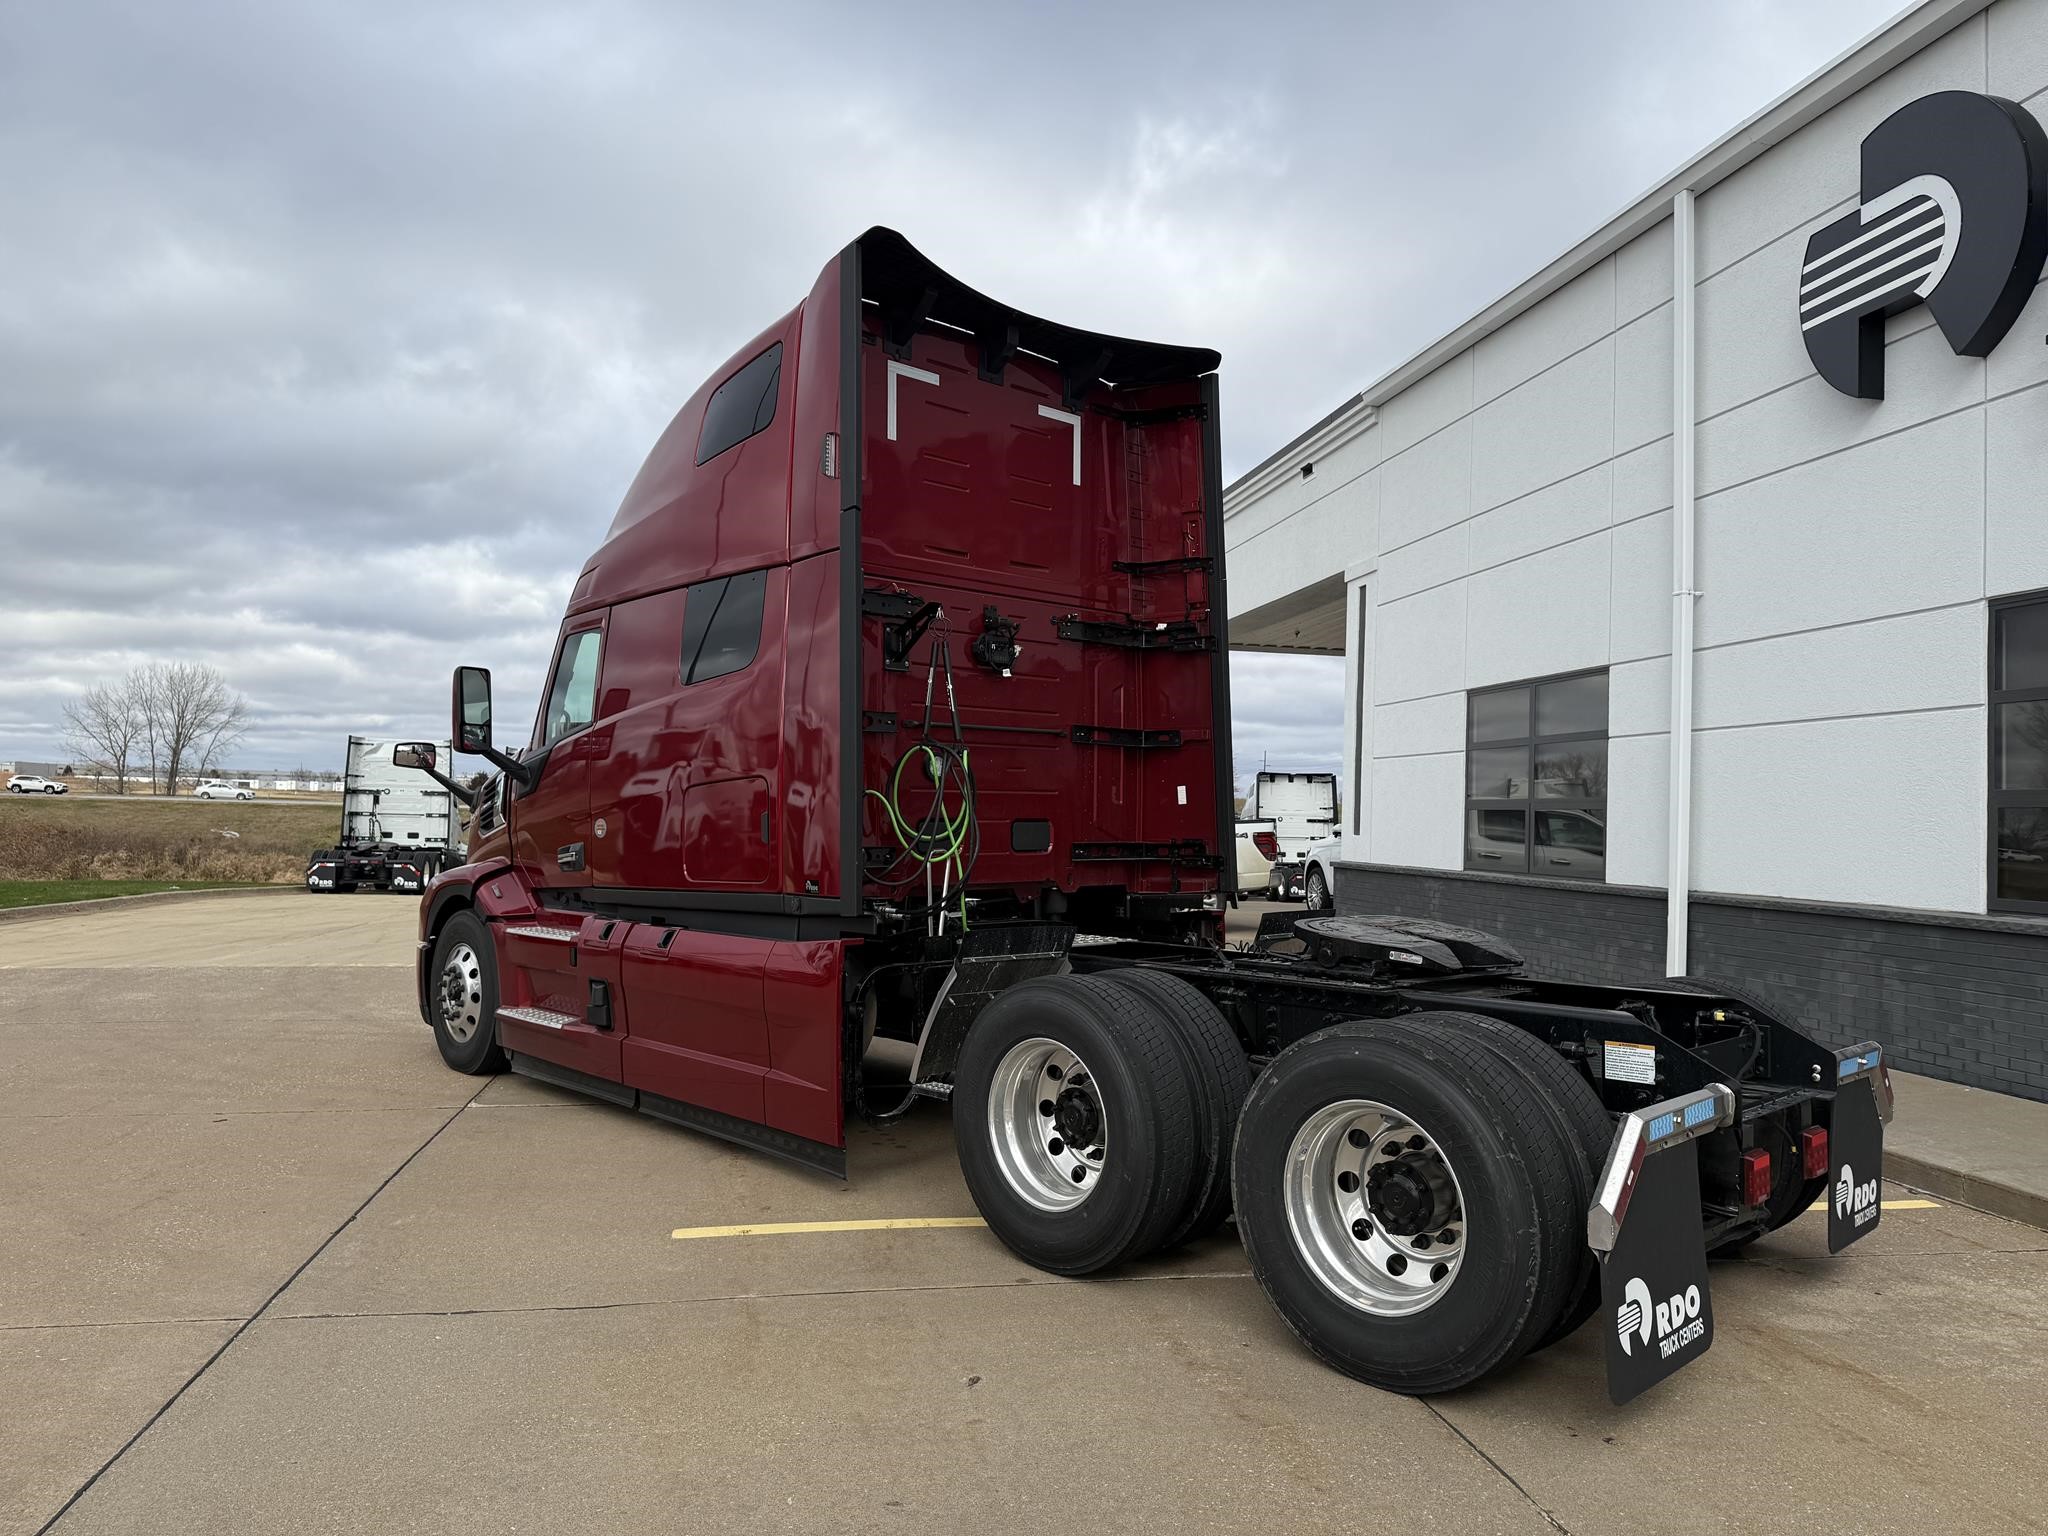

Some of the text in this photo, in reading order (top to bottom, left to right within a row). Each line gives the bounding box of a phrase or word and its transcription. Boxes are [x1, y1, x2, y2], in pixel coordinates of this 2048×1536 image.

[1854, 1178, 1877, 1212] RDO
[1655, 1284, 1701, 1339] RDO
[1659, 1317, 1705, 1359] TRUCK CENTERS
